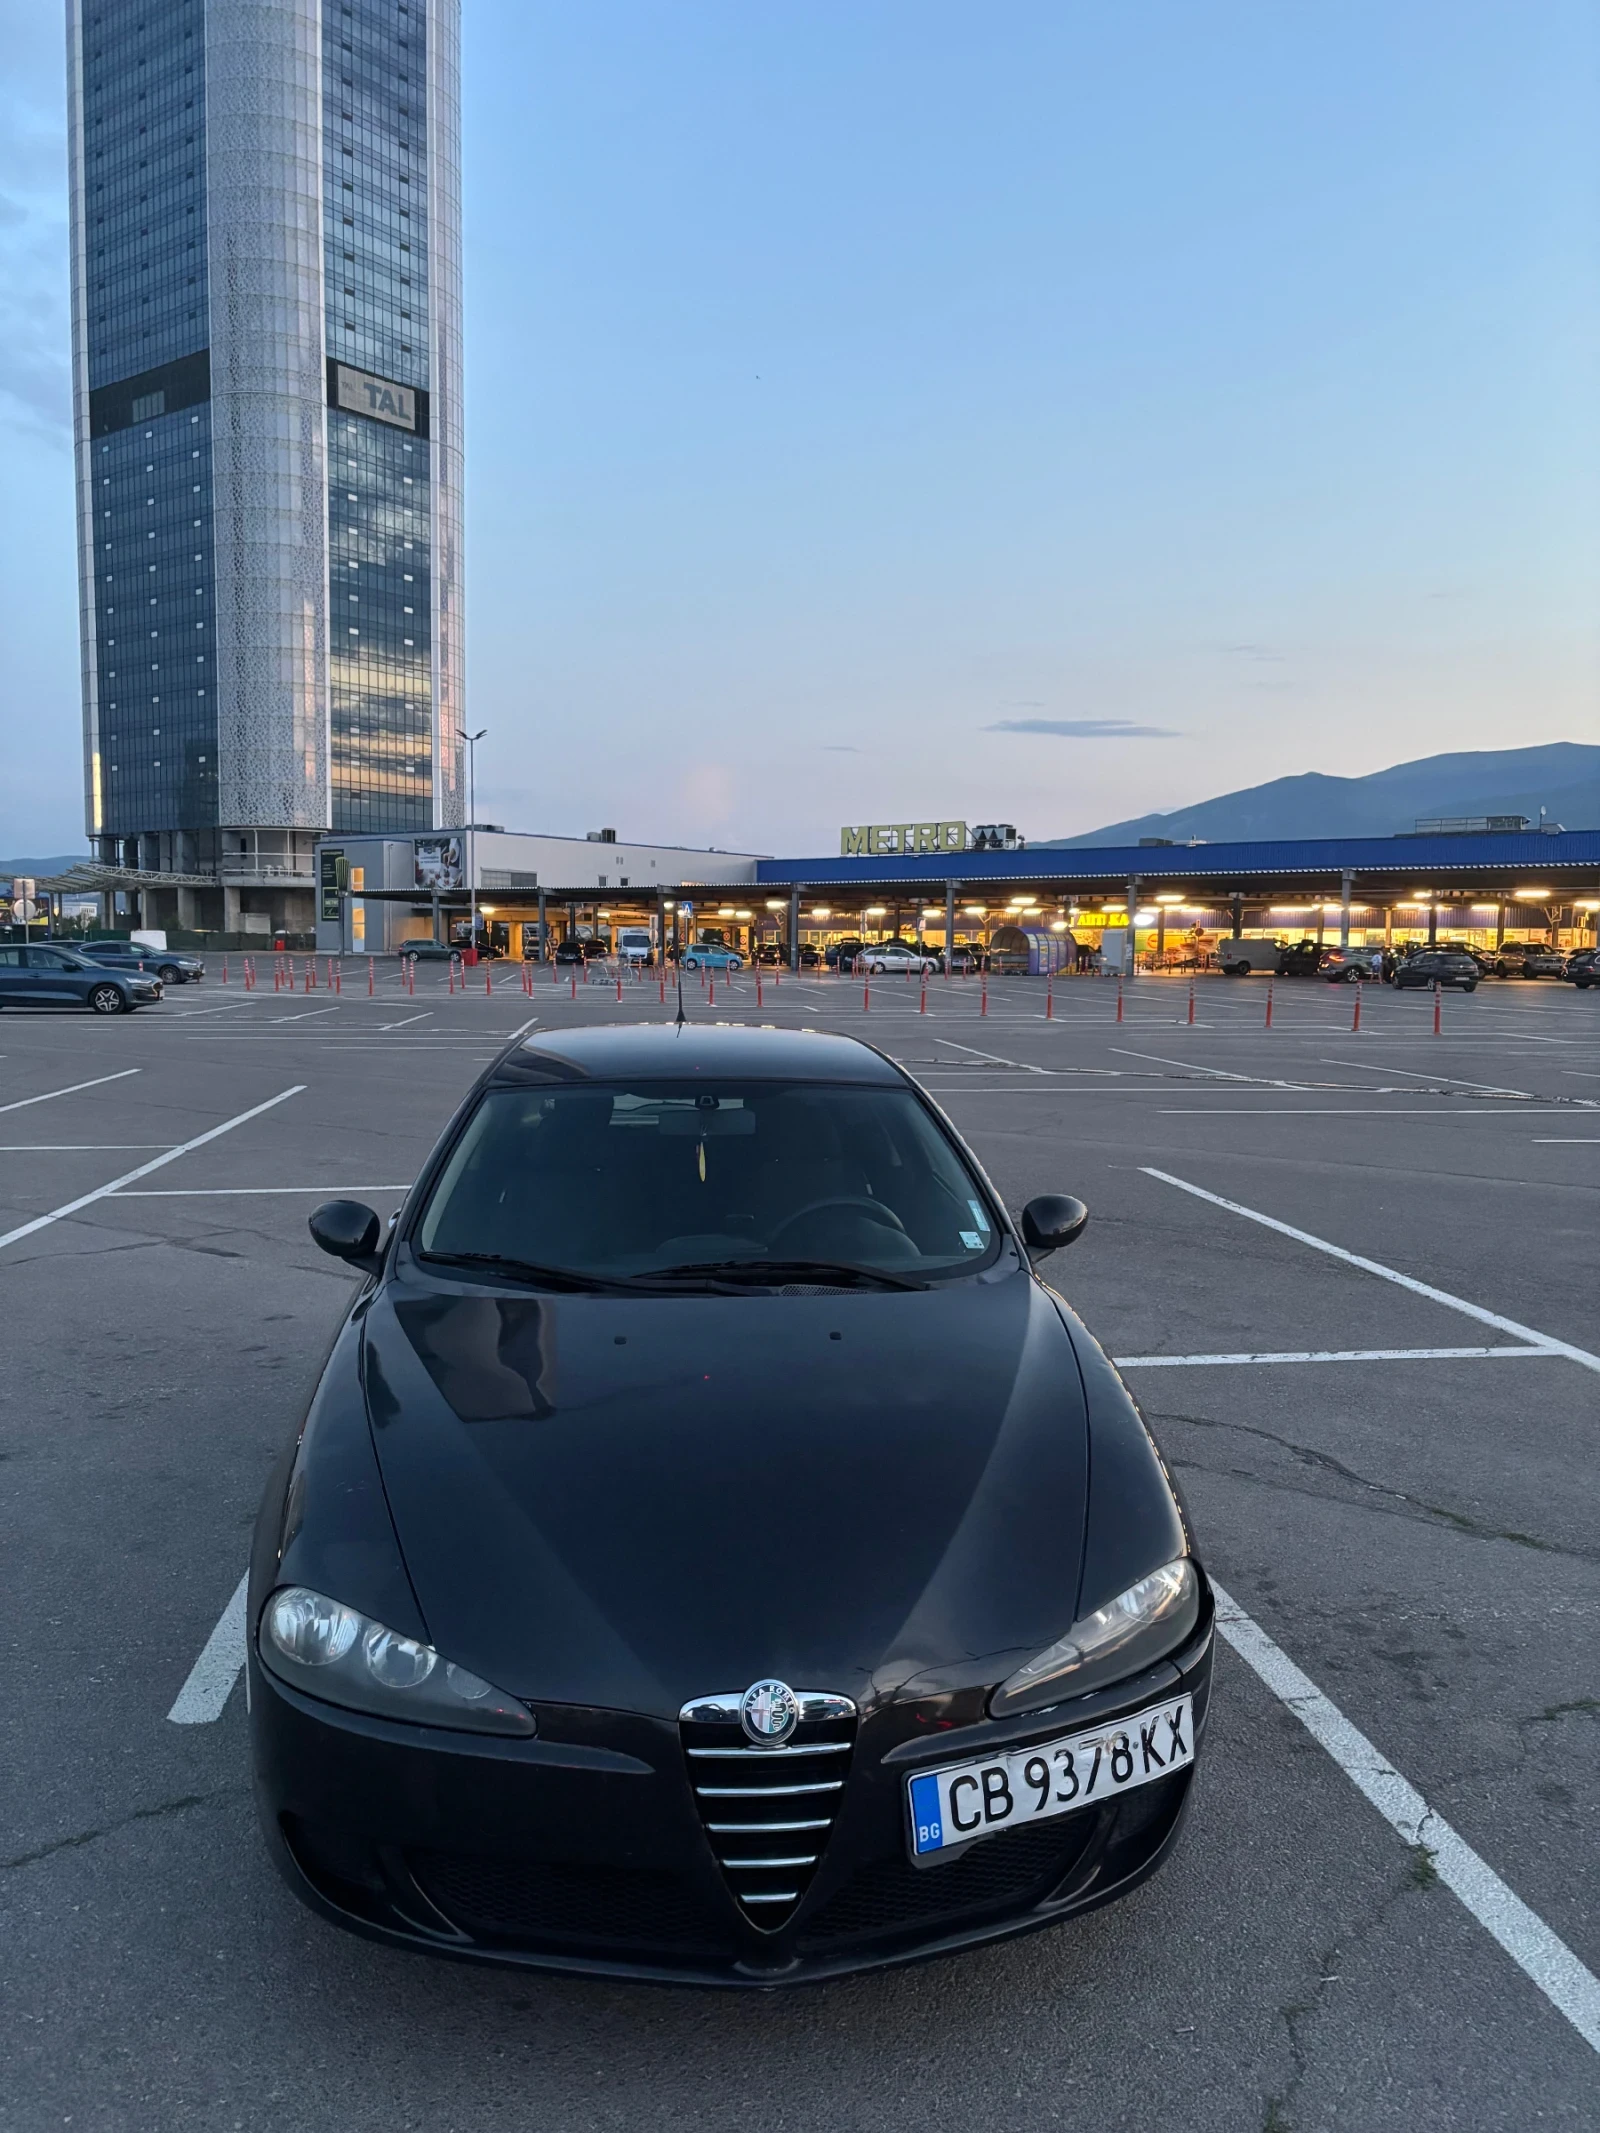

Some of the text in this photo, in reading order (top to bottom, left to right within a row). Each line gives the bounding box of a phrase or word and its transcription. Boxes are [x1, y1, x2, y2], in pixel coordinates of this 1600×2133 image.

[363, 382, 412, 421] TAL
[841, 821, 966, 855] METRO
[745, 1685, 796, 1714] ALFA ROMEO
[1023, 1730, 1134, 1812] 9378
[919, 1822, 941, 1843] BG
